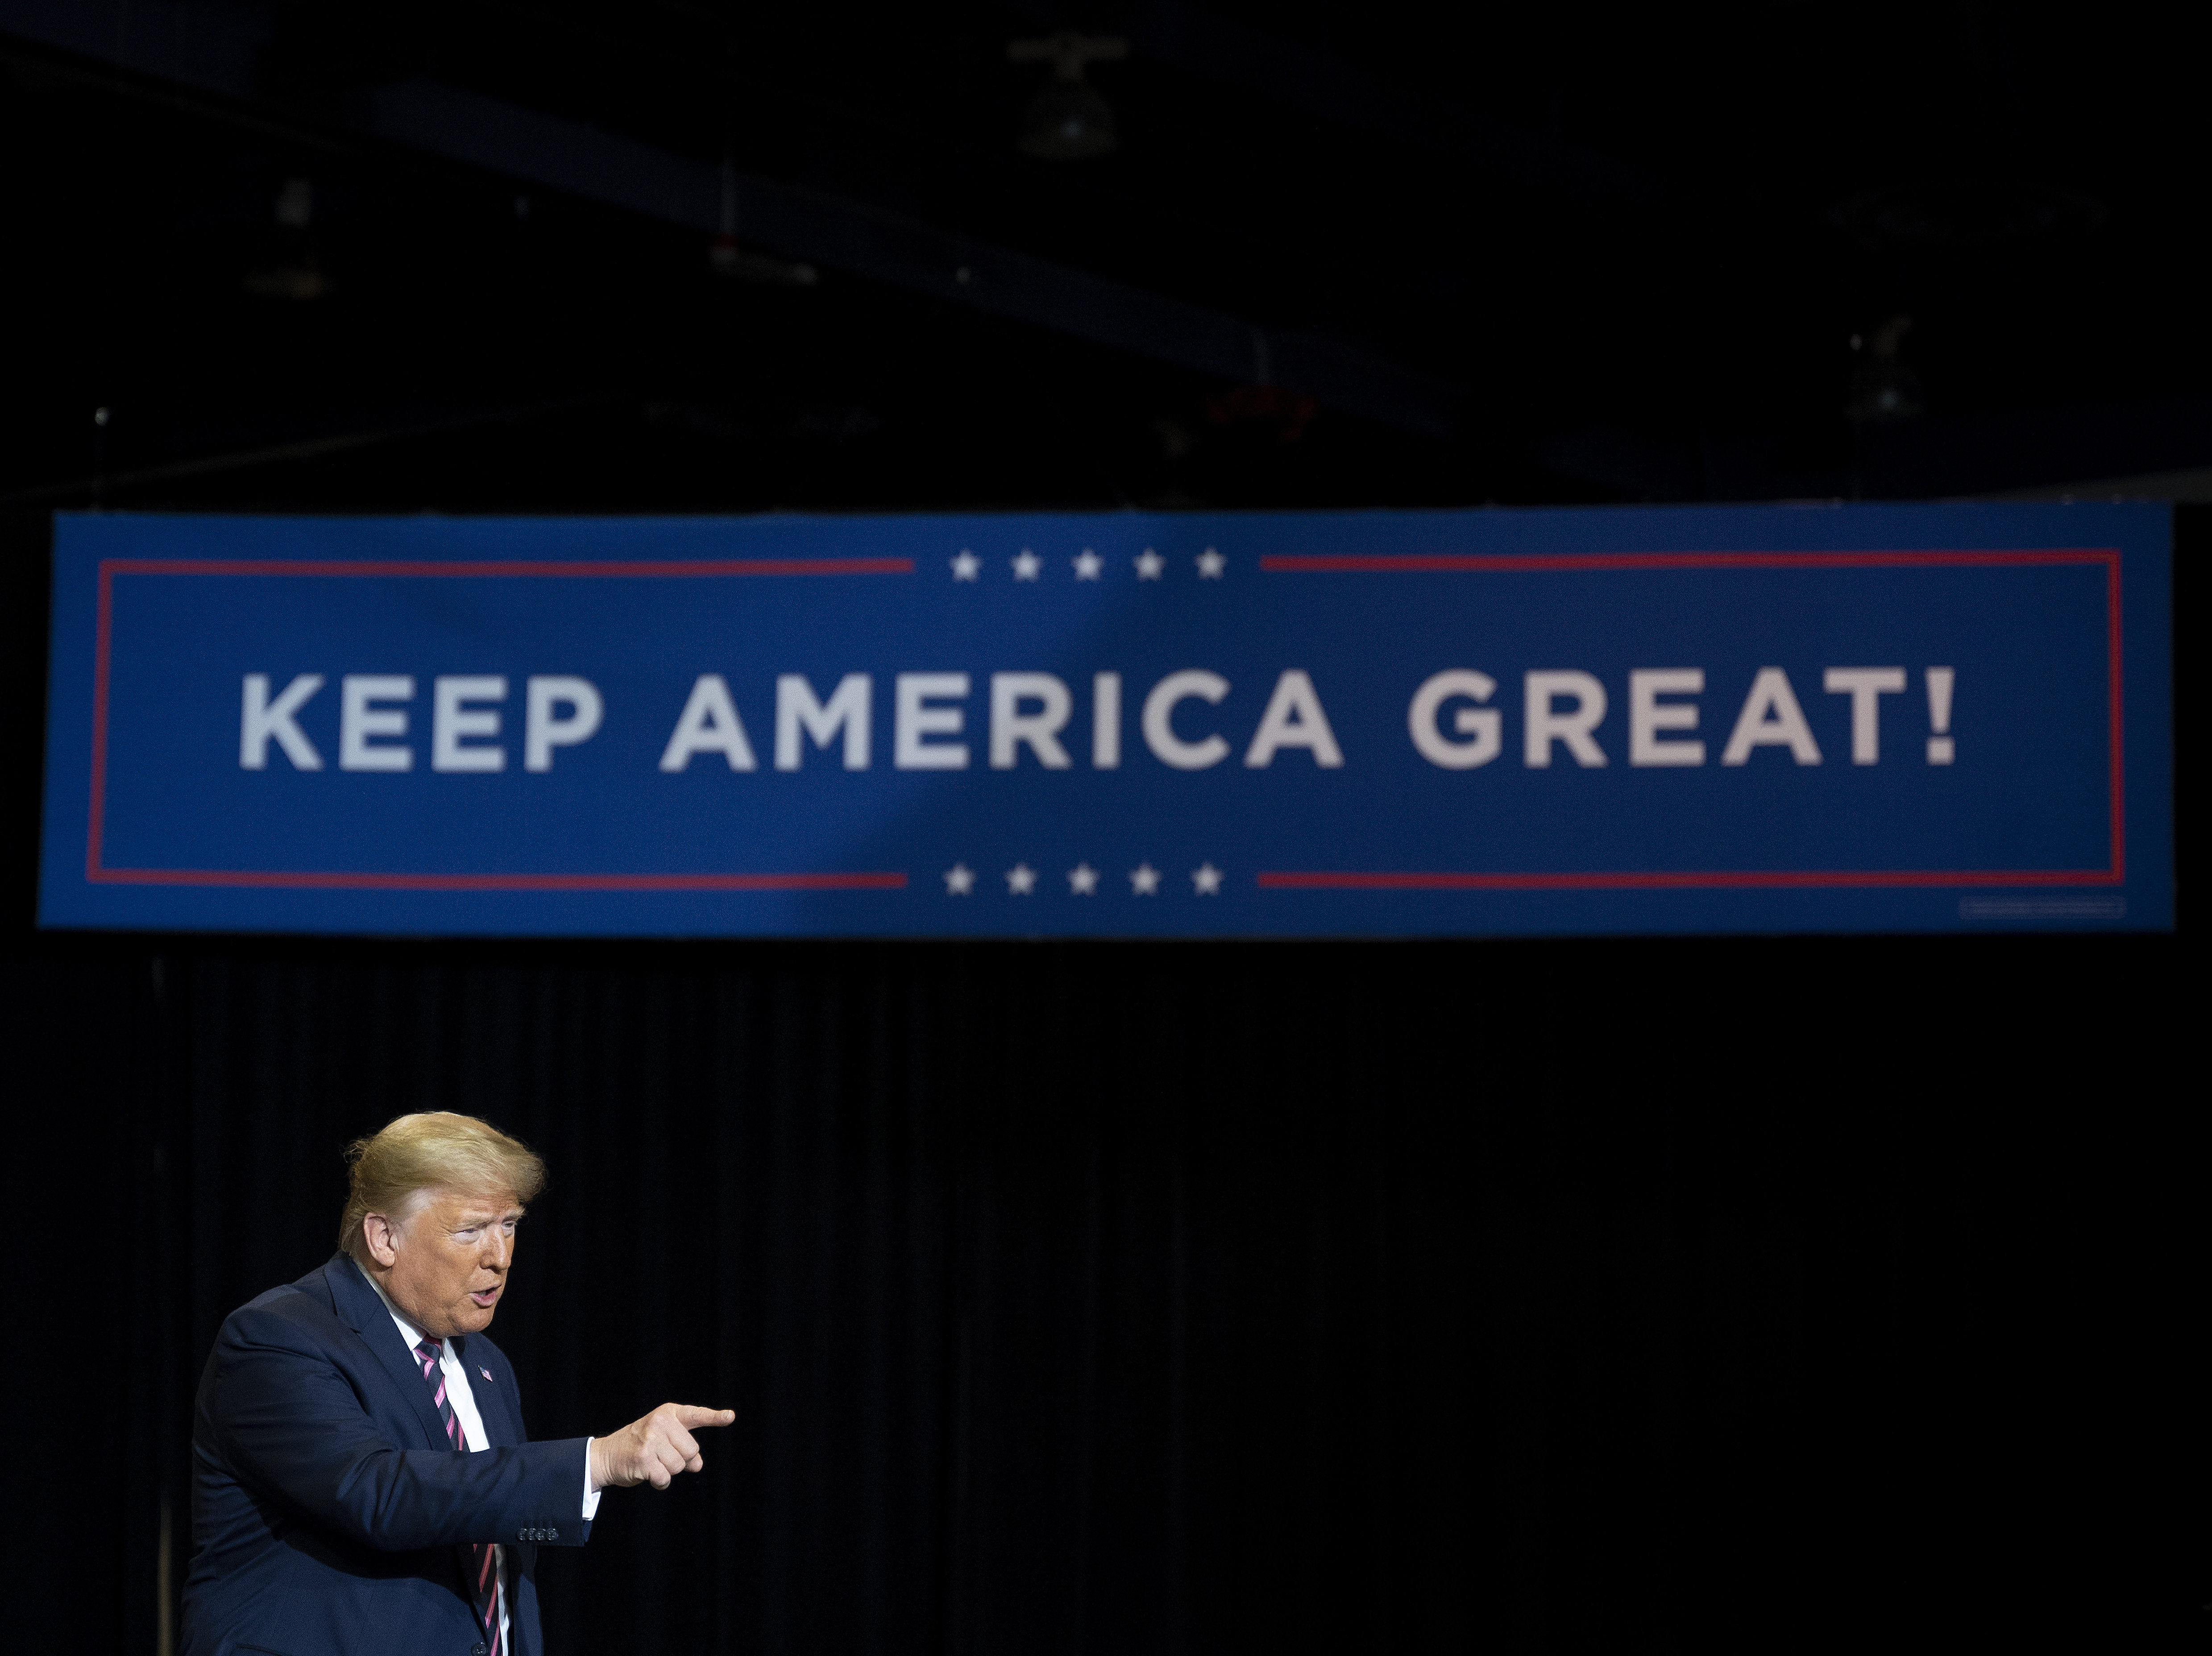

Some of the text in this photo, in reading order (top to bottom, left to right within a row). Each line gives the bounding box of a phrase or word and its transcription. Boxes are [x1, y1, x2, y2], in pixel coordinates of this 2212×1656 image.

[240, 666, 1956, 772] KEEP AMERICA GREAT!
